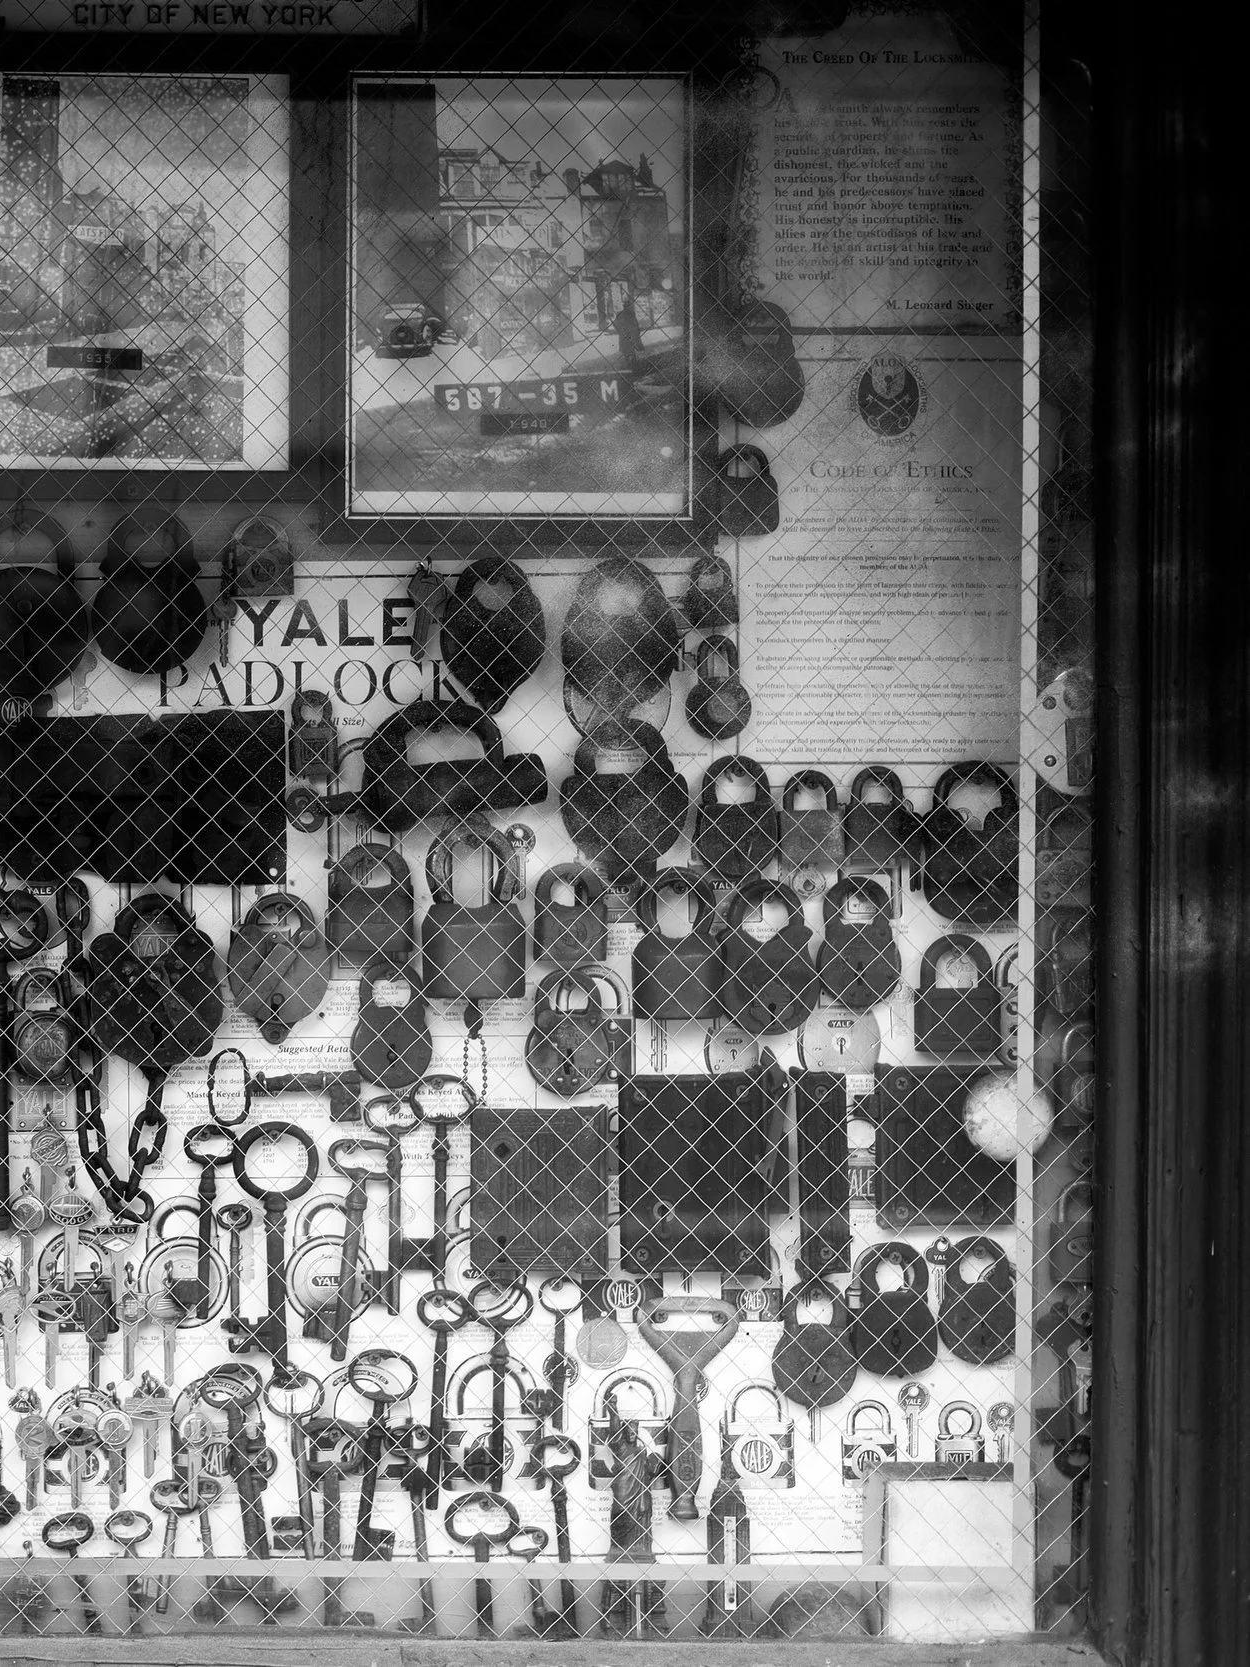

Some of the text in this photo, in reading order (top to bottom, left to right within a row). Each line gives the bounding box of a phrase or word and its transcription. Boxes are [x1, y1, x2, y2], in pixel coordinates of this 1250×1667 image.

[72, 5, 334, 25] CITY OF NEW YORK
[917, 104, 979, 114] remembers
[928, 118, 956, 127] rests
[961, 118, 977, 127] the
[841, 132, 887, 142] property
[968, 132, 983, 142] As
[785, 146, 819, 156] public
[824, 146, 879, 156] guardian,
[941, 146, 958, 156] the
[774, 160, 831, 170] dishonest,
[837, 160, 855, 170] the
[861, 160, 900, 170] wicked
[905, 160, 925, 170] and
[774, 173, 836, 185] avaricious.
[842, 173, 861, 185] For
[866, 173, 924, 185] thousands
[775, 187, 984, 198] he and his predecessors have placed
[775, 201, 973, 211] trust and honor above temptation.
[775, 215, 793, 225] His
[798, 215, 841, 225] honesty
[862, 215, 939, 225] incorruptible.
[944, 215, 963, 225] His
[775, 229, 805, 238] allies
[810, 229, 828, 238] are
[833, 229, 852, 238] the
[856, 229, 917, 238] custodians
[922, 229, 932, 238] of
[961, 229, 981, 238] and
[813, 243, 828, 252] He
[866, 243, 897, 252] artist
[902, 243, 912, 252] at
[918, 243, 933, 252] his
[775, 257, 793, 267] the
[843, 257, 853, 267] of
[859, 257, 884, 267] skill
[889, 257, 909, 267] and
[913, 257, 962, 267] integrity
[775, 272, 834, 281] the world.
[886, 300, 993, 311] M. Leonard Singer
[600, 380, 620, 402] M
[204, 598, 415, 647] TRAE YALE
[156, 659, 478, 708] PADLOCK
[510, 839, 528, 848] YALE
[25, 886, 53, 895] YALE
[278, 1043, 324, 1056] Suggested
[186, 1089, 240, 1099] Maste Keyed
[427, 1087, 453, 1096] Keyed
[402, 1152, 423, 1161] With
[54, 1214, 90, 1225] DODGE
[98, 1226, 136, 1234] FORD
[933, 1254, 947, 1262] YAL
[315, 1276, 339, 1286] YAL
[611, 1281, 636, 1307] YALE
[742, 1291, 764, 1310] YALE
[904, 1398, 922, 1406] YALE
[740, 1440, 774, 1474] YALE
